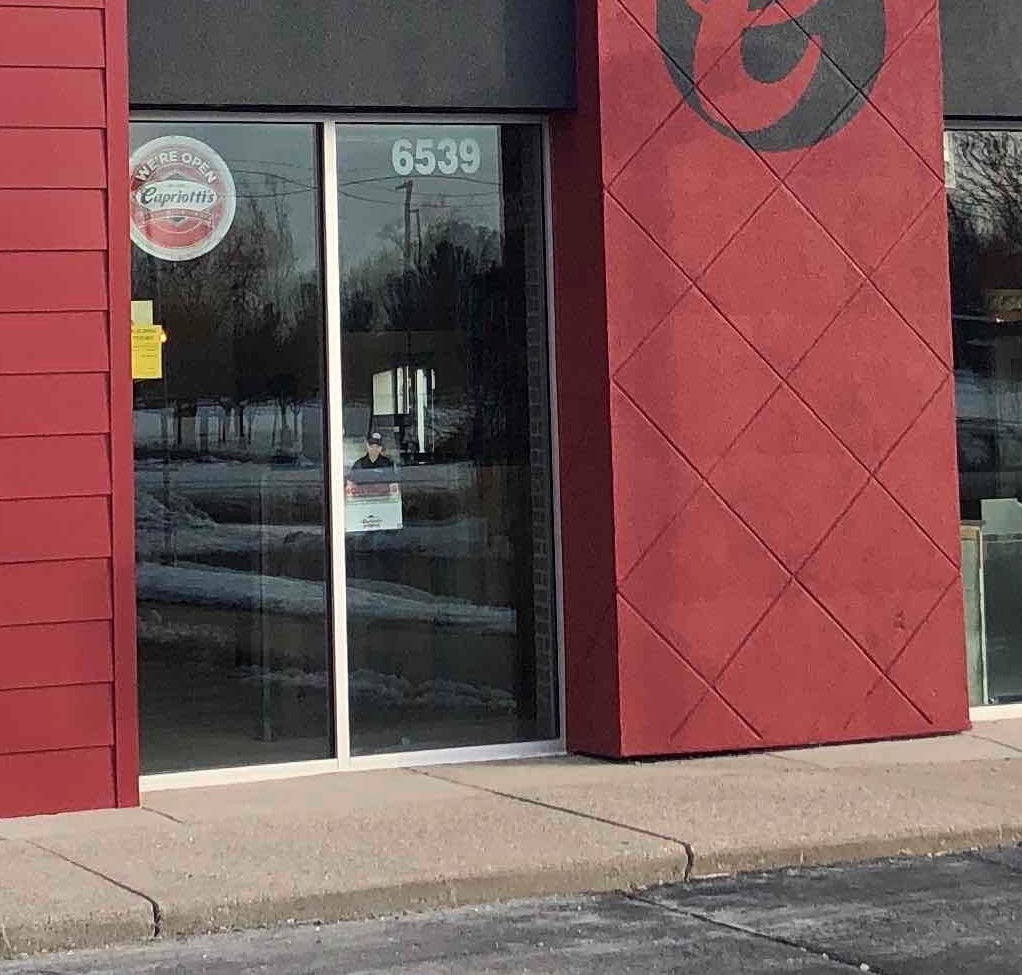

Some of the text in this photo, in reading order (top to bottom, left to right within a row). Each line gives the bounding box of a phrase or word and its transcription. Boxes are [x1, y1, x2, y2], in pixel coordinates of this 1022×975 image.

[135, 150, 217, 184] WE'RE OPEN
[392, 138, 481, 175] 6539
